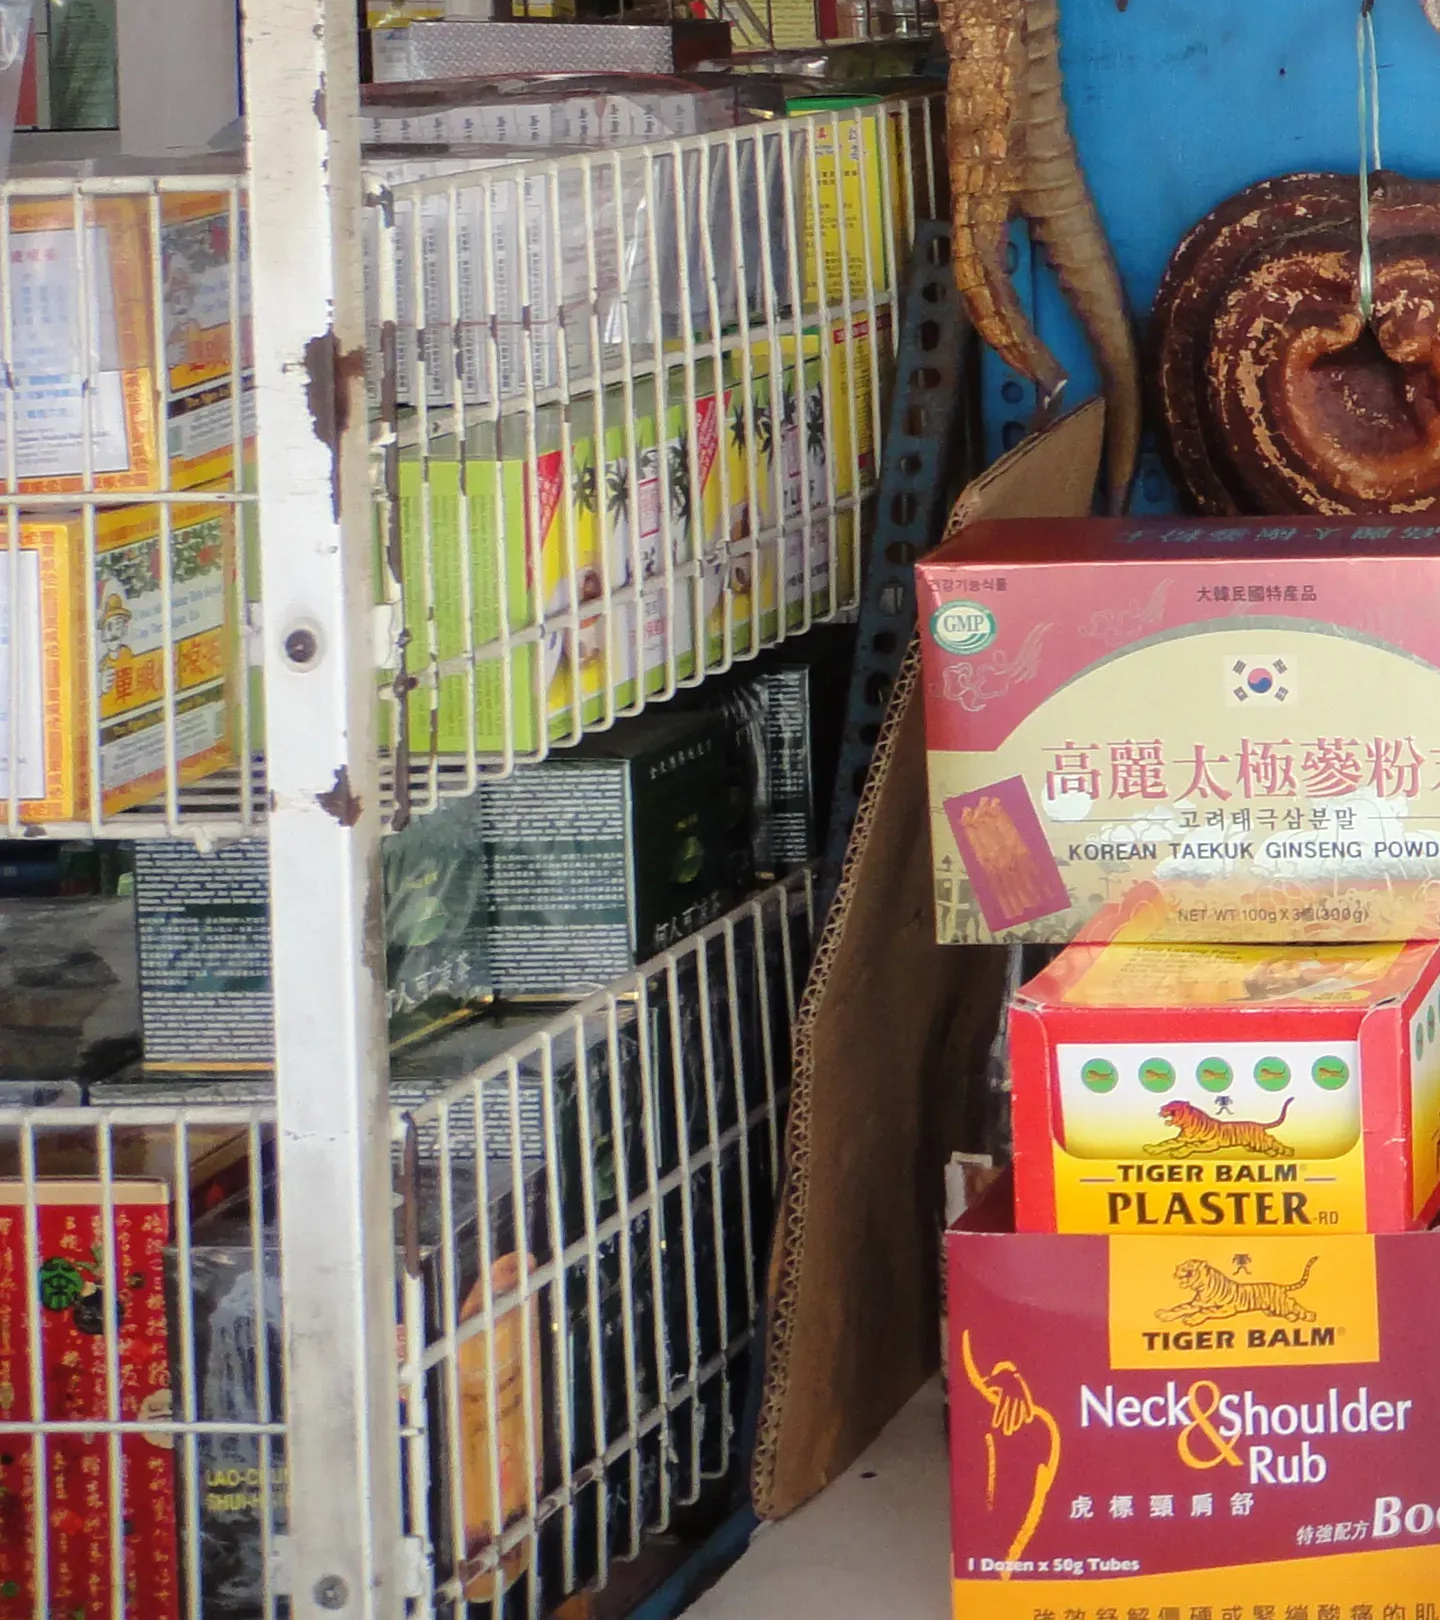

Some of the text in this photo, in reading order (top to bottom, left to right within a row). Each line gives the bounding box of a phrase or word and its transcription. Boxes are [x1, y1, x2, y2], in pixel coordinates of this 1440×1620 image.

[943, 614, 985, 632] GMP
[1179, 808, 1357, 830] 고려태극삼분말
[1069, 842, 1156, 861] KOREAN
[1171, 841, 1254, 860] TAEKUK
[1265, 840, 1362, 860] GINSENG
[1178, 908, 1208, 923] NET
[1117, 1163, 1299, 1183] TIGER BALM
[1142, 1327, 1336, 1351] TIGER BALM
[1080, 1380, 1412, 1469] Neck & Shoulder
[1248, 1440, 1328, 1485] Rub
[1070, 1492, 1255, 1519] 虎標頸肩舒
[1296, 1520, 1369, 1545] 特強配方
[981, 1557, 1034, 1573] Dozen
[1053, 1556, 1085, 1577] 50g
[1087, 1556, 1140, 1573] Tubes
